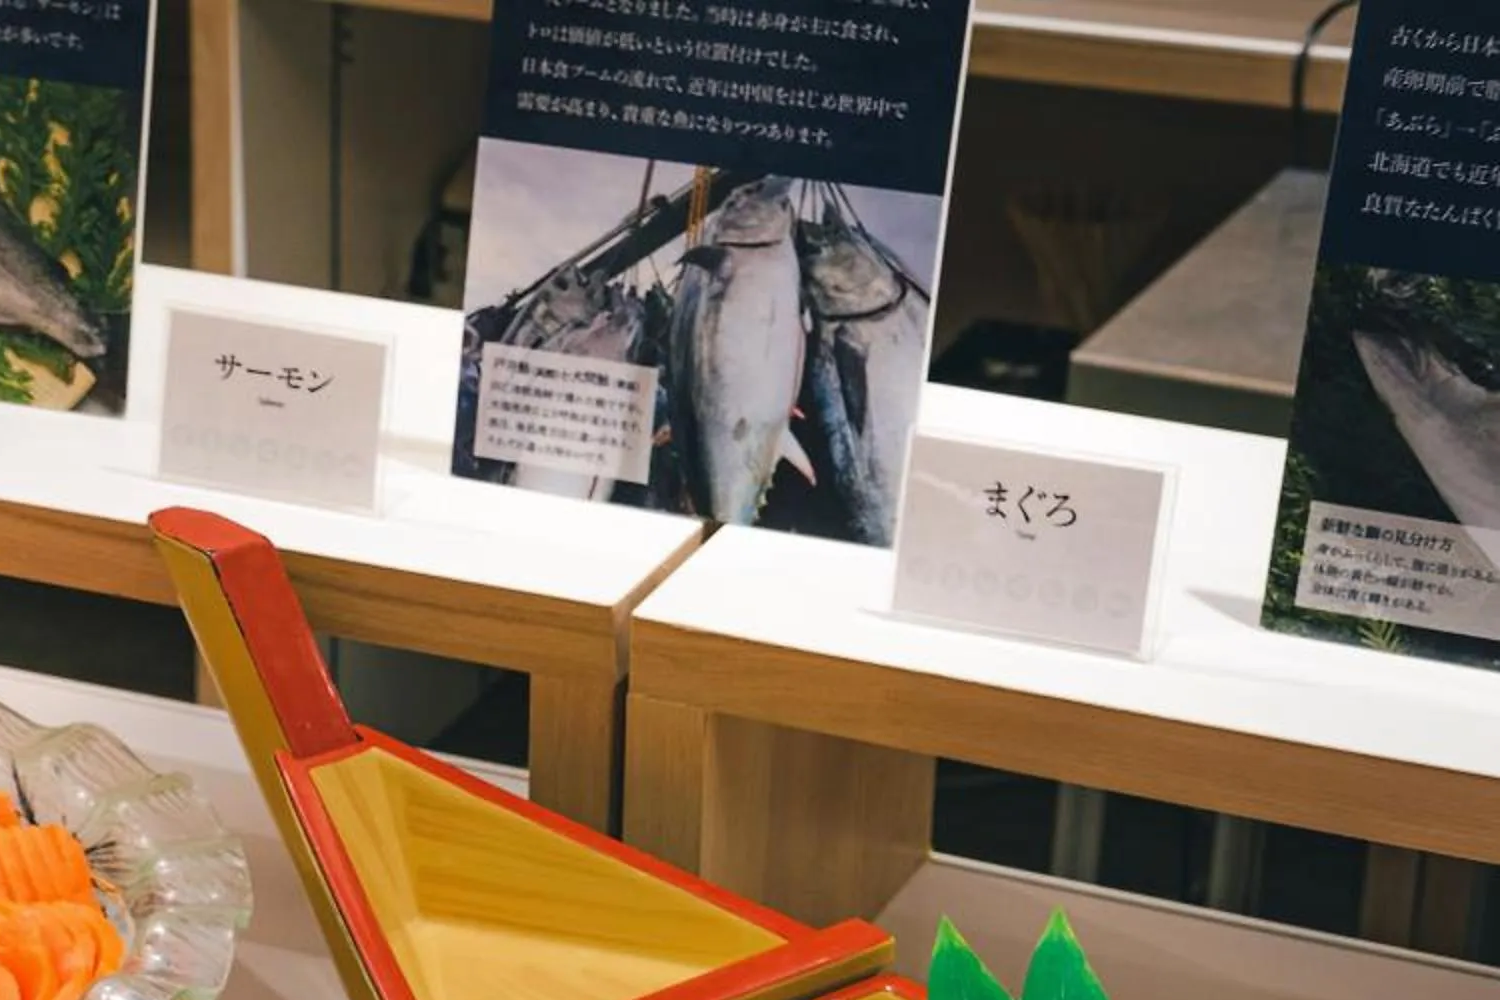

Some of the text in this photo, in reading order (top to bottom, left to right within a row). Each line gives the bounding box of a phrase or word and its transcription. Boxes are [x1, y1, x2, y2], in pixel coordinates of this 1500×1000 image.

[1360, 192, 1500, 230] 良質なたんぱく
[214, 354, 335, 393] サーモン
[983, 481, 1077, 527] まぐろ
